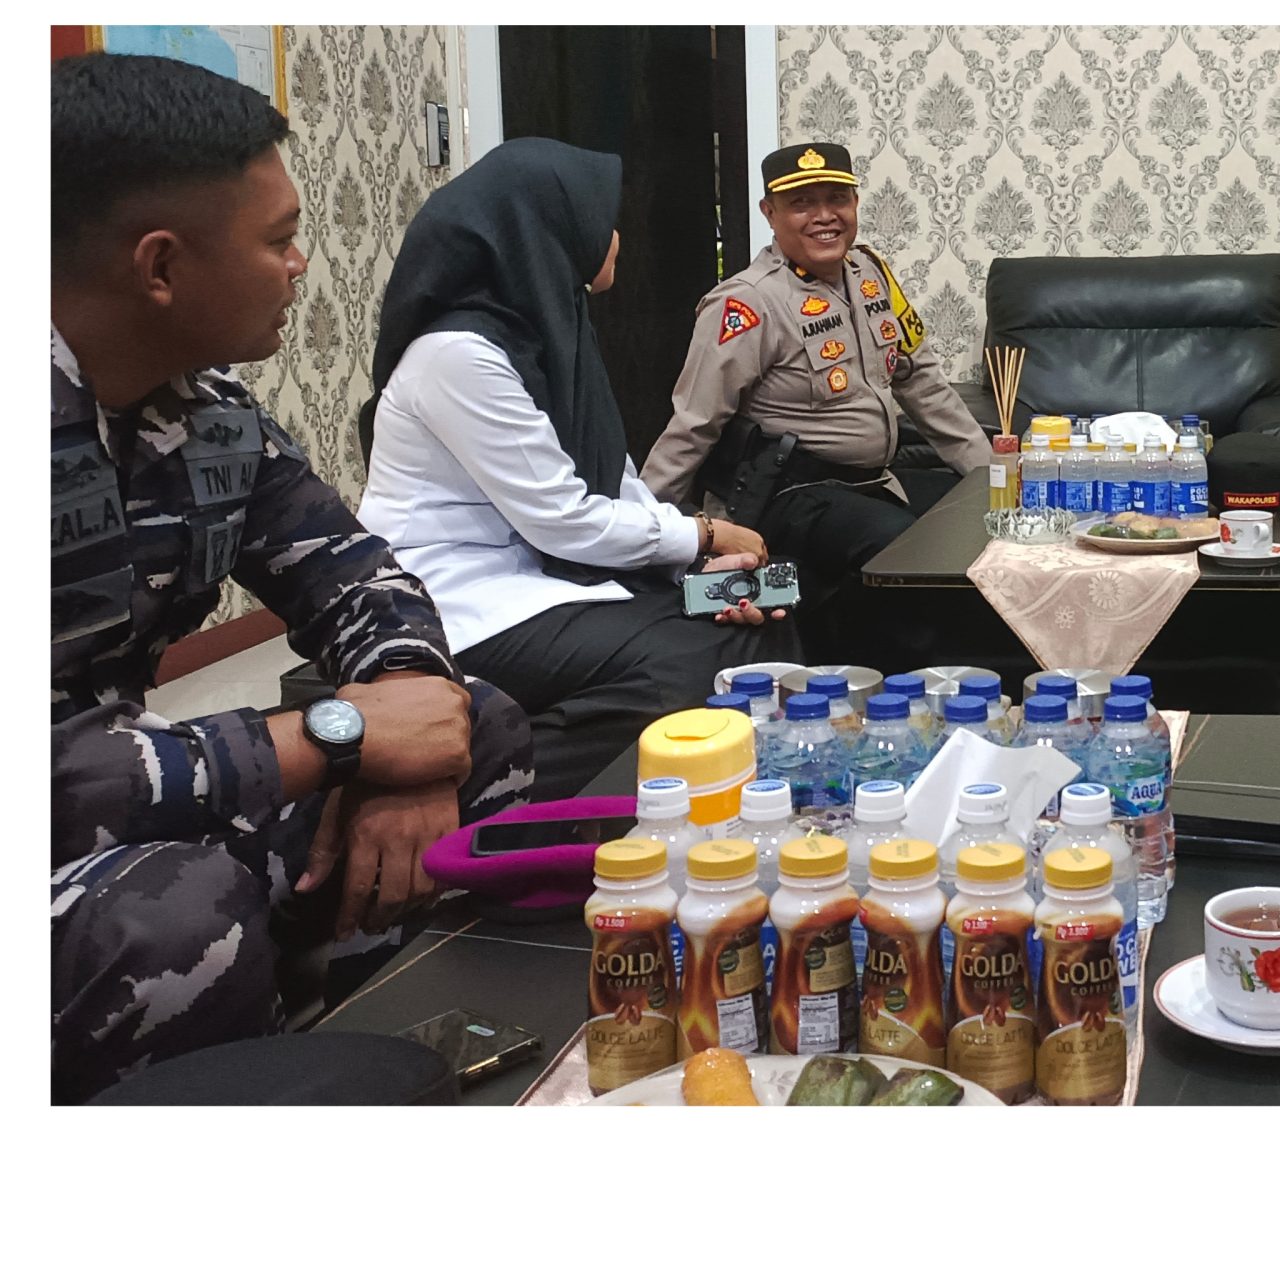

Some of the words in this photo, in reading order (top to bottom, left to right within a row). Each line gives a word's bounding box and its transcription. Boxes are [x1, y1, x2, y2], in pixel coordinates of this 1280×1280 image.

[200, 463, 233, 496] TNI
[1227, 496, 1277, 504] WAKAPOLRES
[1131, 781, 1162, 800] AQUA
[594, 950, 664, 976] GOLDA
[867, 944, 908, 975] LDA
[962, 952, 1024, 978] GOLDA
